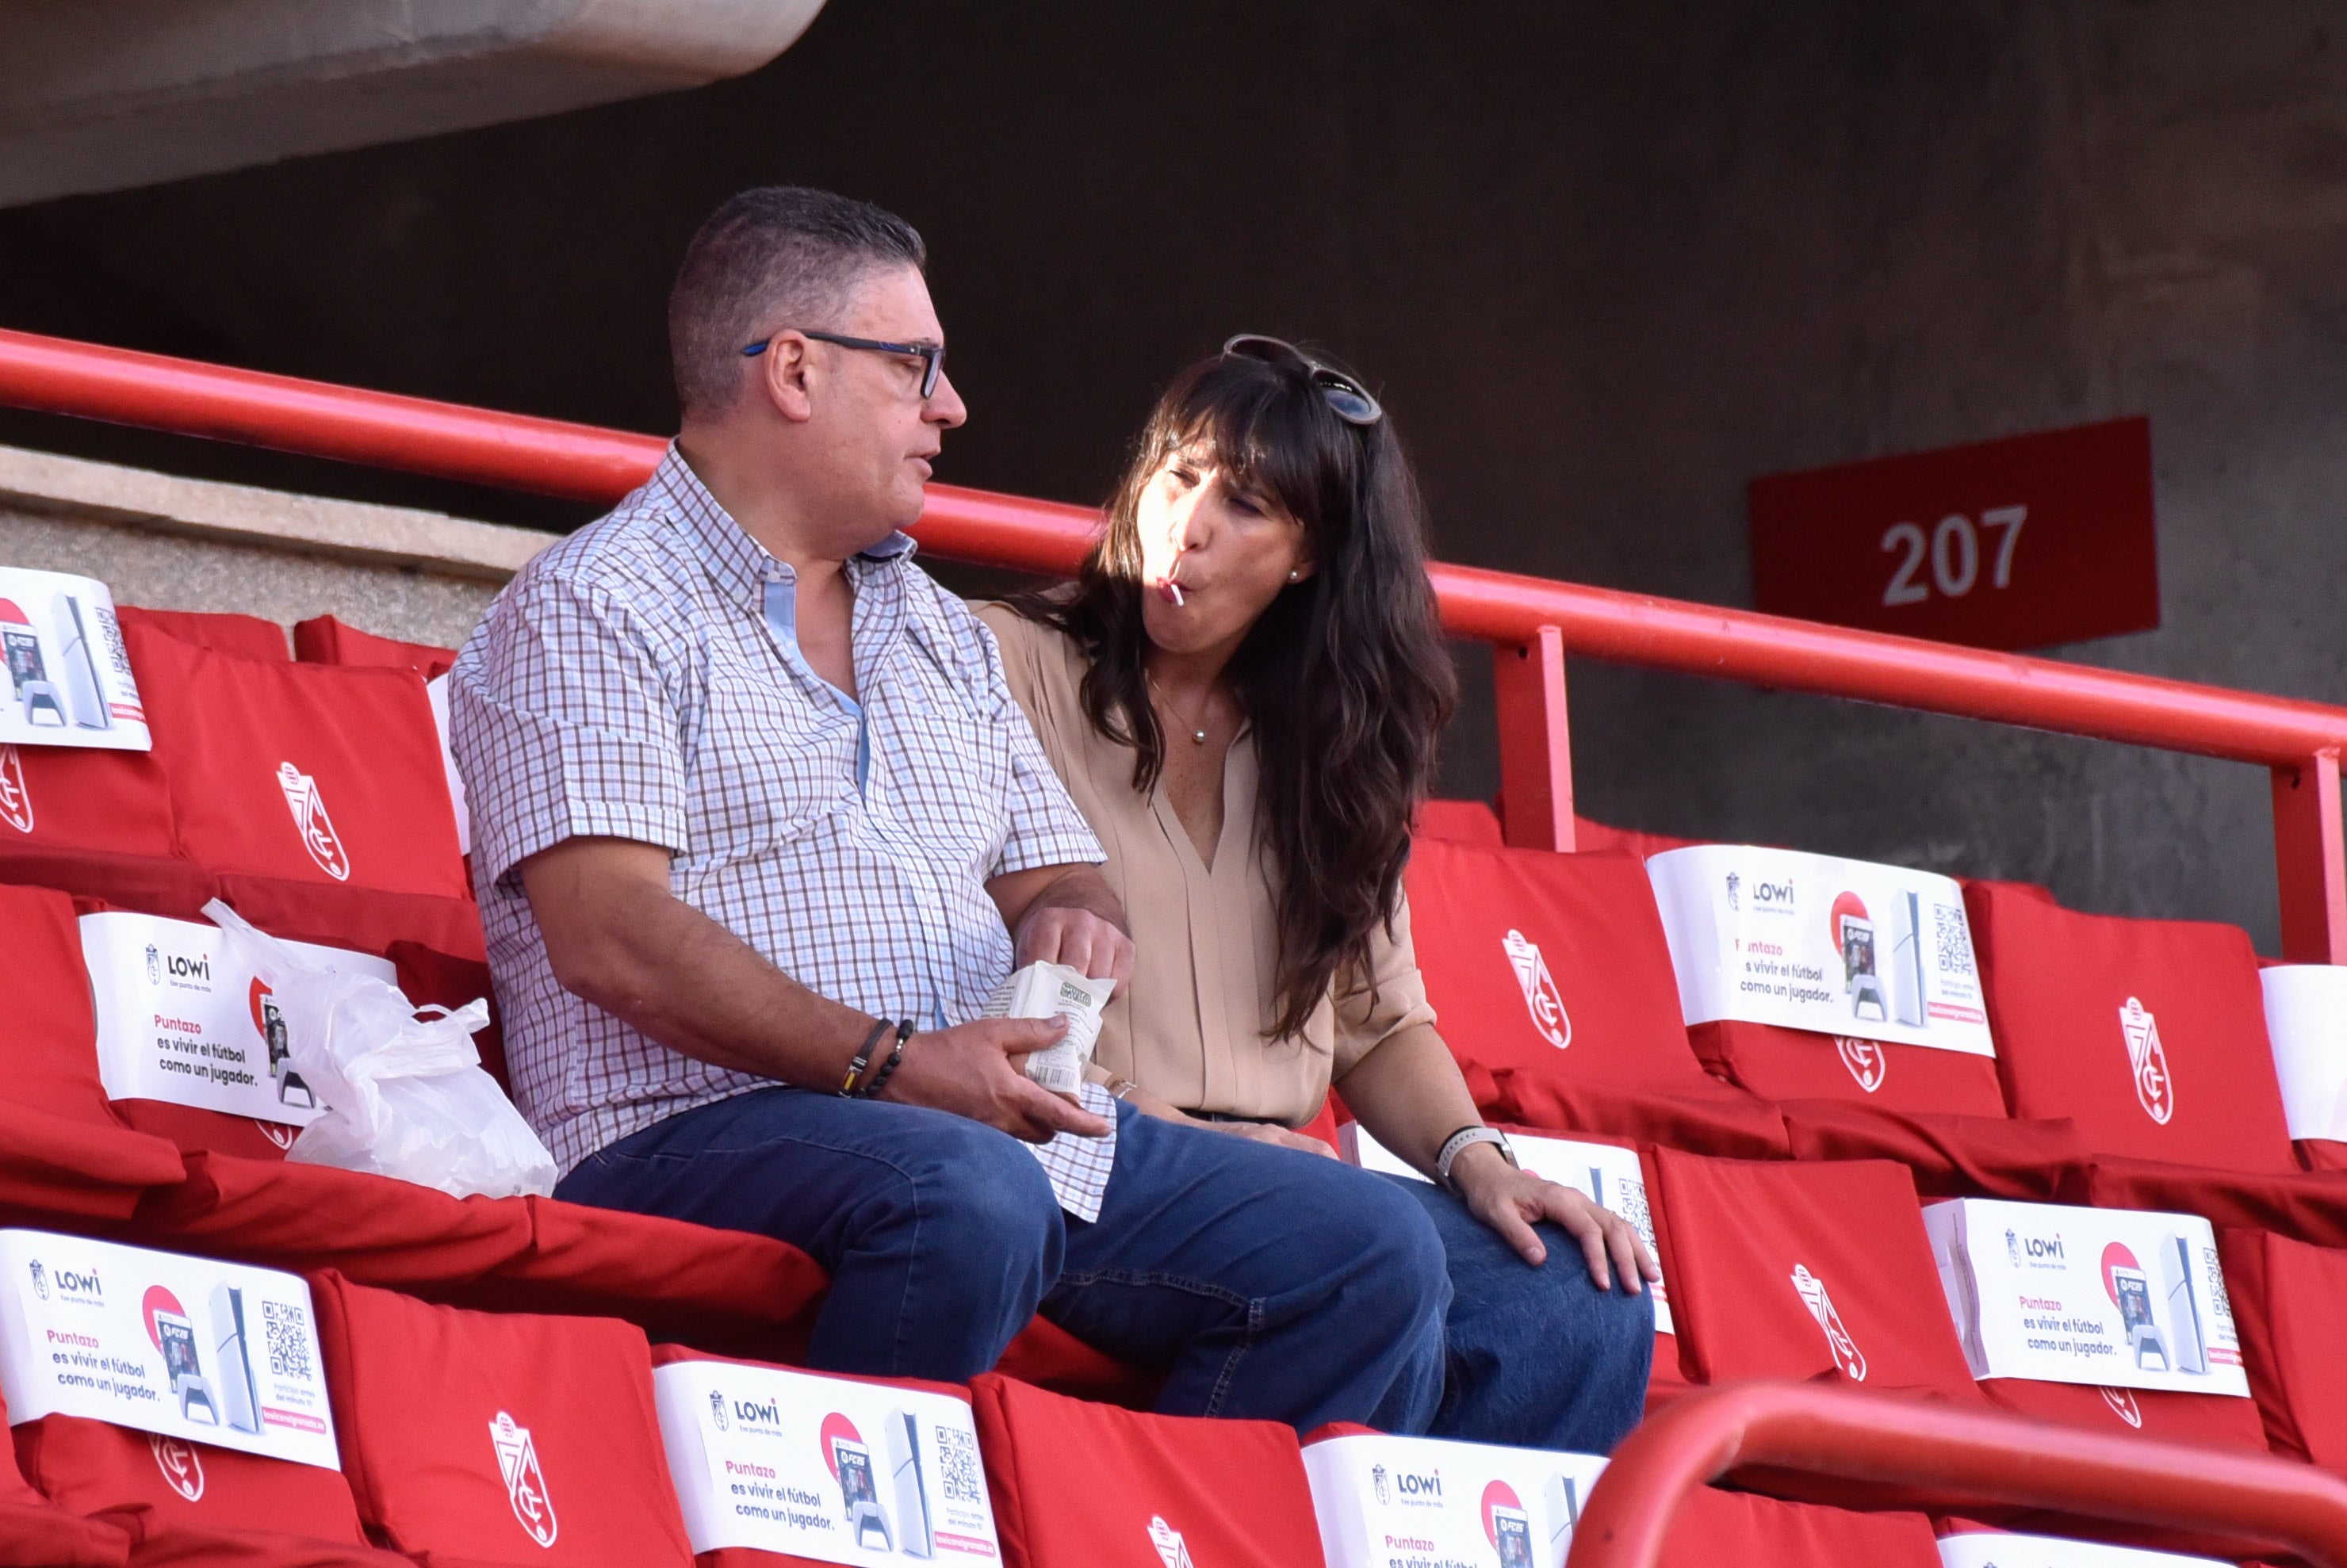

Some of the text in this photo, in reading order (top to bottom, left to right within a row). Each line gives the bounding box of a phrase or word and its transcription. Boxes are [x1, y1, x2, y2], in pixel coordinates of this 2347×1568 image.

[1880, 504, 2027, 606] 207
[1753, 959, 1778, 975] vivir
[1781, 964, 1790, 977] el
[1792, 964, 1822, 981] fútbol
[1740, 981, 1834, 1003] como un jugador.
[155, 1014, 202, 1034] Puntazo
[158, 1036, 246, 1064] es vivir el fútbol
[159, 1058, 258, 1087] como un jugador.
[2019, 1295, 2062, 1311] Puntazo
[2023, 1315, 2104, 1334] es vivir el fútbol
[46, 1329, 100, 1348] Puntazo
[2027, 1337, 2117, 1358] como un jugador.
[52, 1351, 146, 1379] es vivir el fútbol
[57, 1373, 160, 1402] como un jugador.
[725, 1460, 776, 1479] Puntazo
[731, 1482, 821, 1507] es vivir el fútbol
[736, 1504, 835, 1531] como un jugador.
[1385, 1535, 1434, 1551] Puntazo
[1389, 1558, 1403, 1568] es
